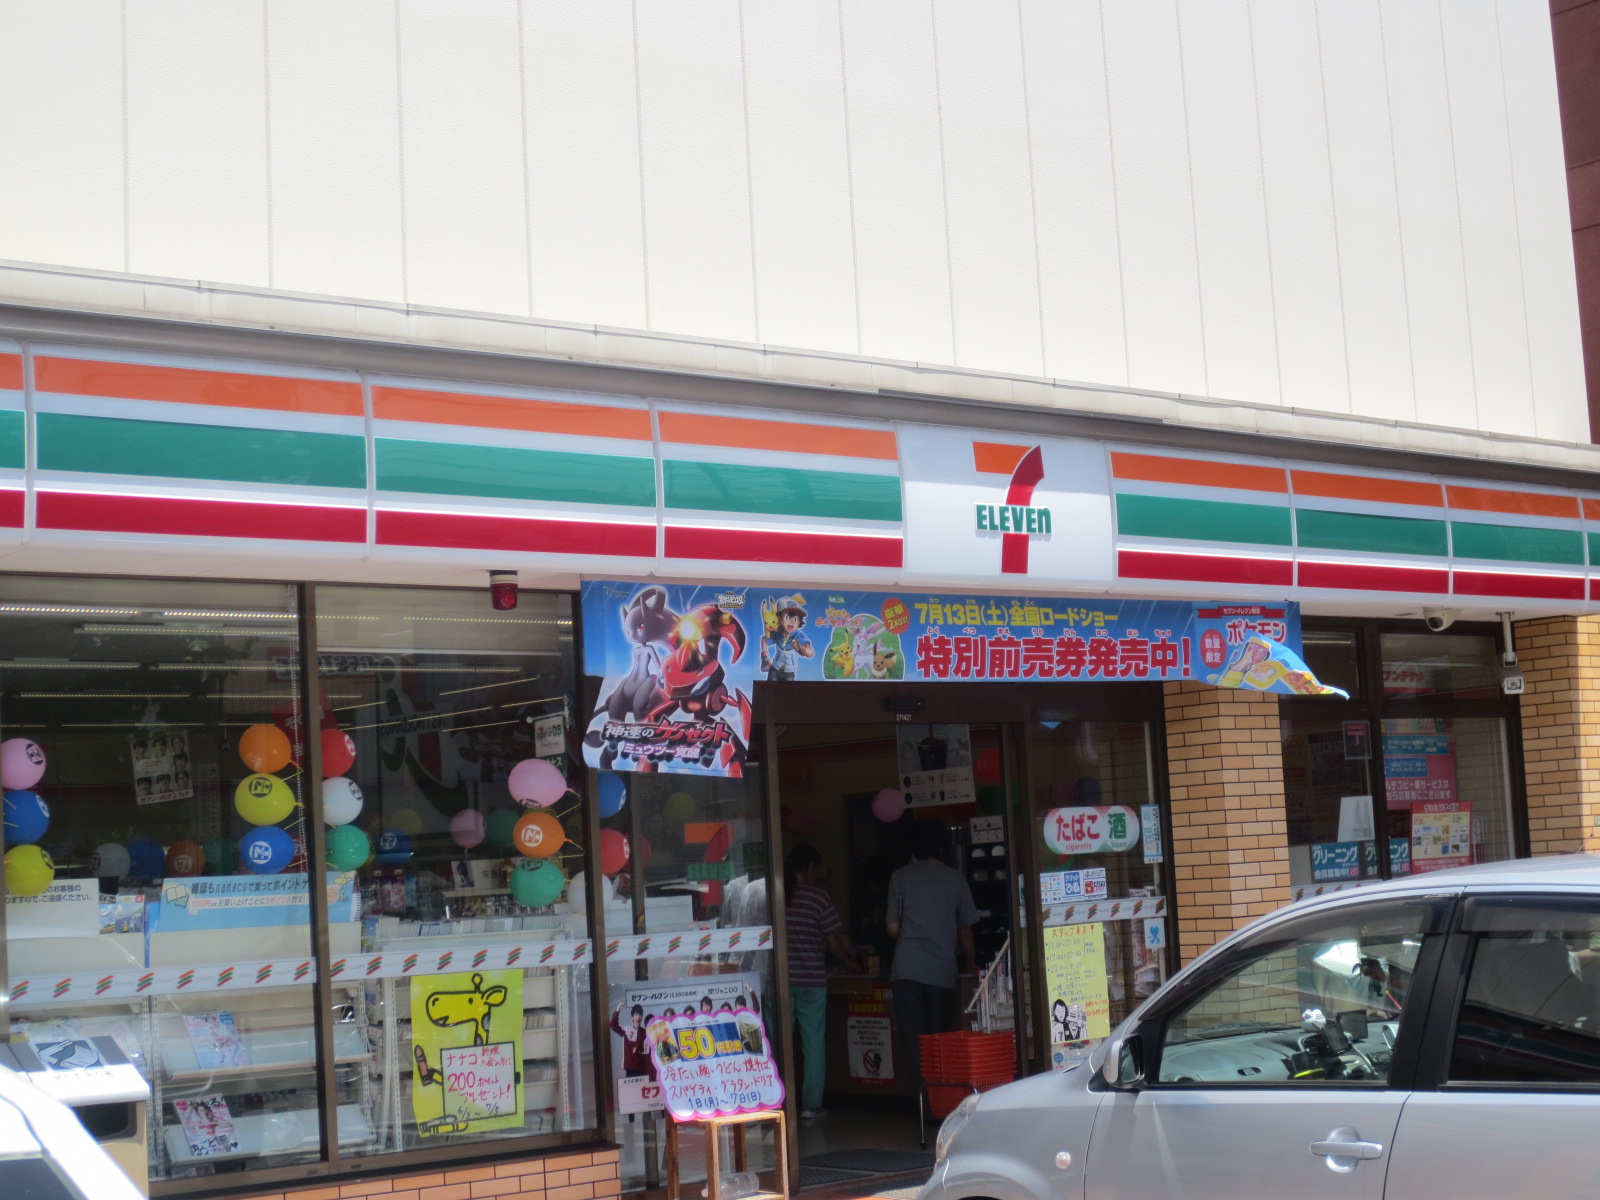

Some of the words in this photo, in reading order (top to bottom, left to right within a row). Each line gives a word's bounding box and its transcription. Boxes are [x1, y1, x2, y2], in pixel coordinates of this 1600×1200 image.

[972, 441, 1045, 574] 7
[917, 635, 1191, 679] 特別前売券発売中!
[1056, 813, 1100, 842] たばこ
[1107, 812, 1127, 839] 酒
[1065, 842, 1093, 851] cigarette
[1313, 845, 1358, 865] クリーニング
